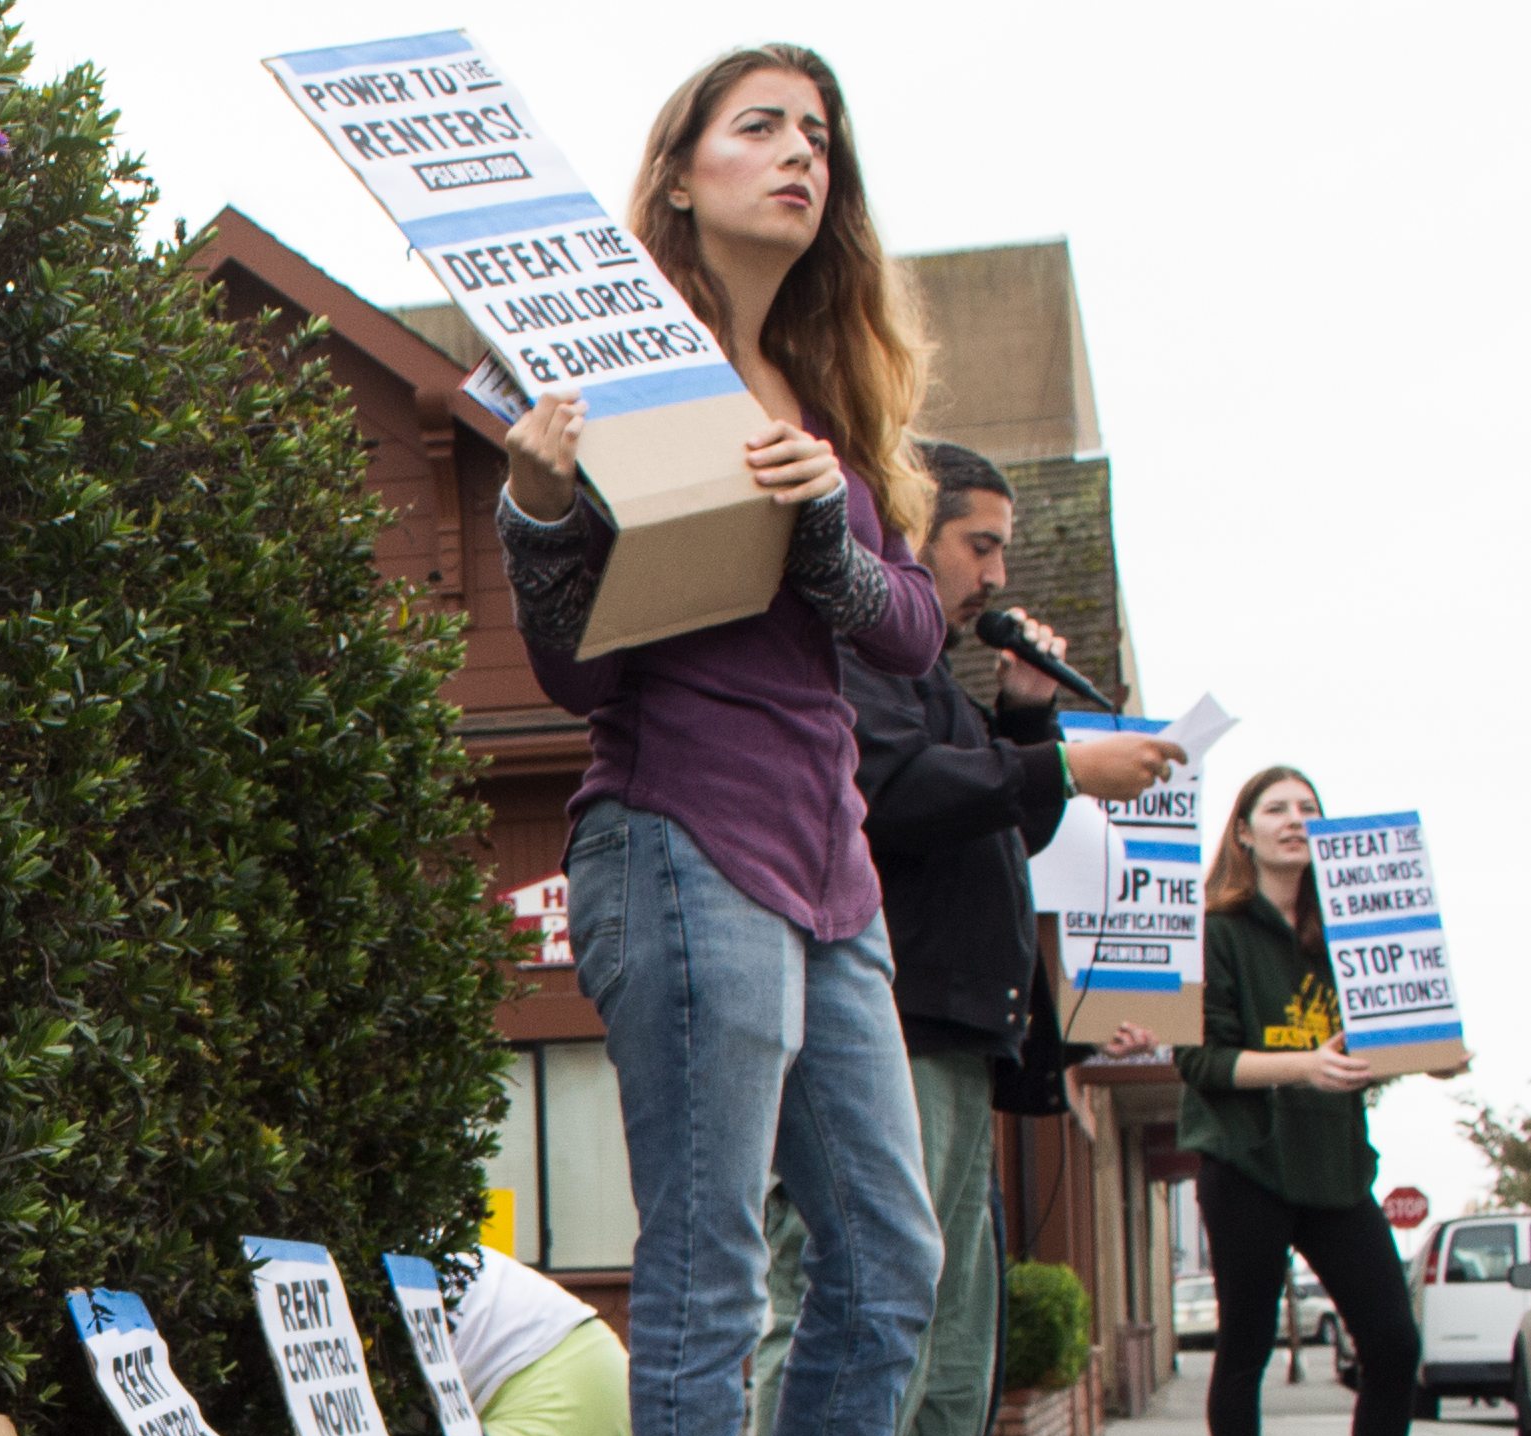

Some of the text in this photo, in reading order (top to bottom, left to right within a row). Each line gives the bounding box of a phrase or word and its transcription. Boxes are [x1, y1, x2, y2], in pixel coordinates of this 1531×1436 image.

[303, 58, 495, 113] POWER TO THE
[341, 102, 534, 161] RENTERS!
[441, 226, 636, 292] DEFEAT THE
[484, 278, 664, 335] LANDLORDS
[519, 346, 560, 383] &
[549, 320, 711, 377] BANKERS!
[1317, 827, 1422, 861] DEFEAT THE
[1156, 878, 1198, 904] THE
[1326, 859, 1424, 889] LANDLORDS
[1328, 887, 1434, 917] & BANKERS!
[1337, 943, 1446, 978] STOP THE
[1345, 979, 1452, 1011] EVICTIONS!
[1384, 1197, 1428, 1218] STOP
[275, 1278, 333, 1332] RENT
[113, 1345, 172, 1412] RENT
[284, 1337, 358, 1384] CONTROL
